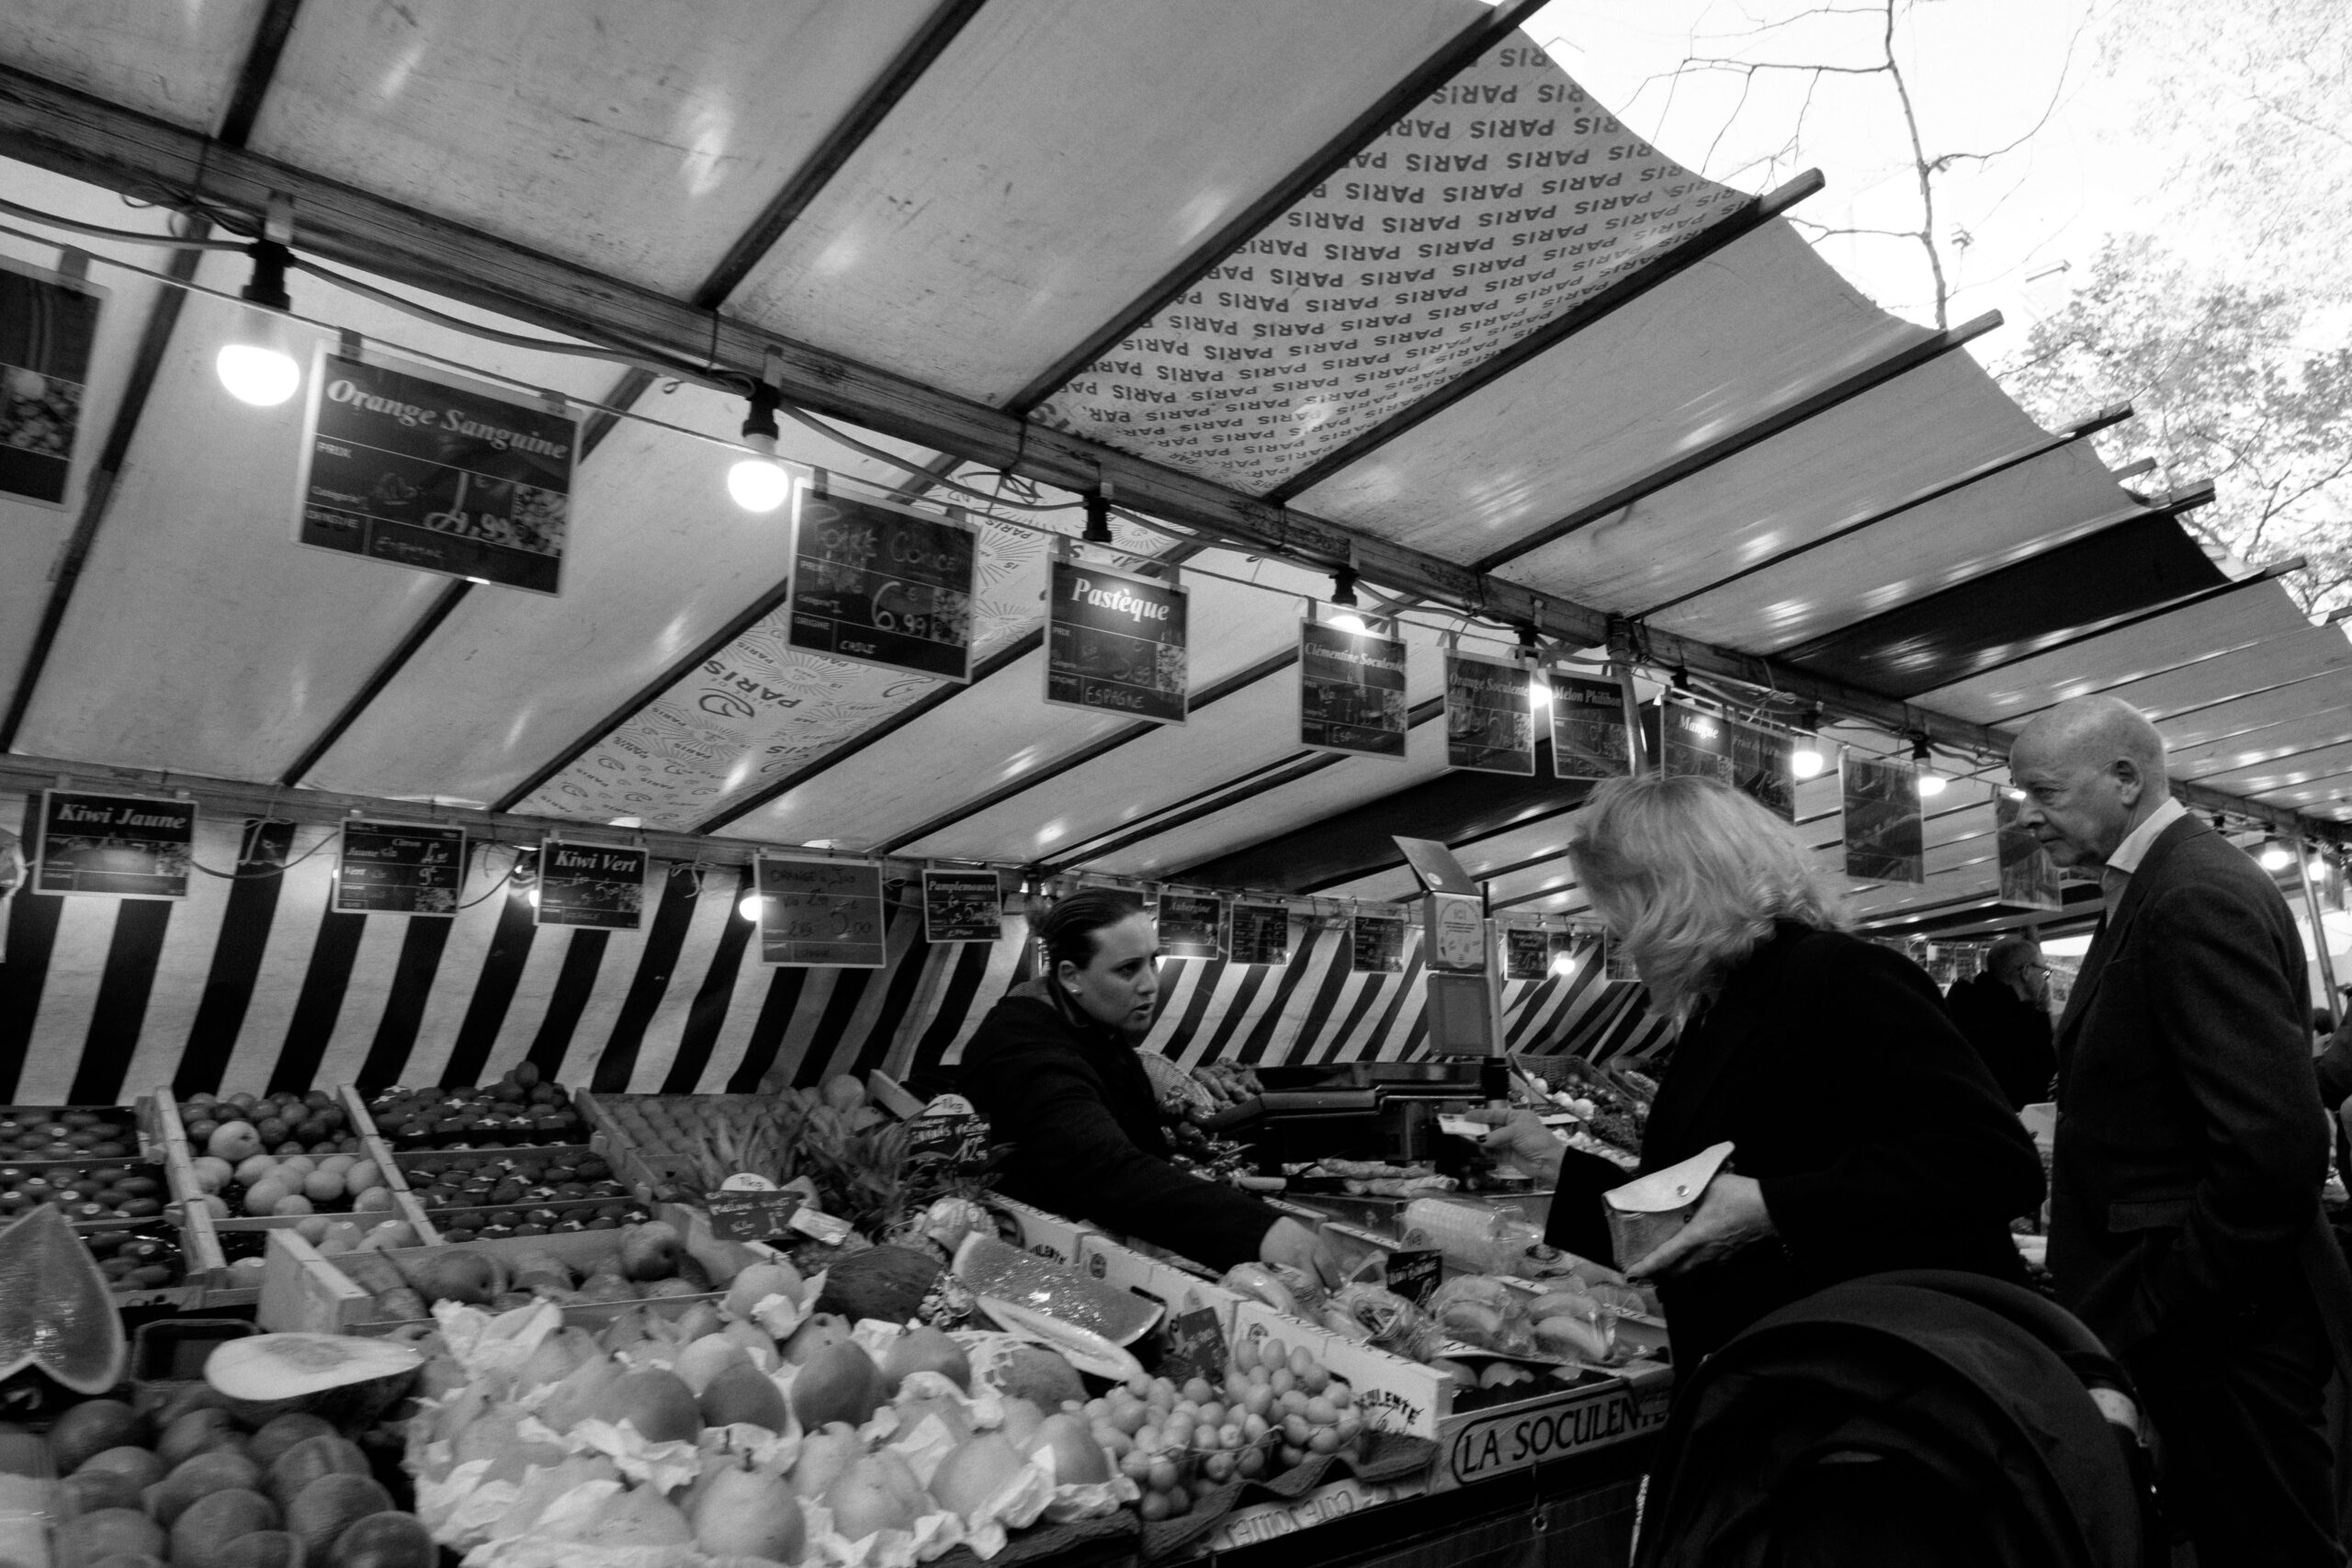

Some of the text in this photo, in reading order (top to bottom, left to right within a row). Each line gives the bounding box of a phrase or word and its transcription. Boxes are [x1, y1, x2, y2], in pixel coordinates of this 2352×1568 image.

[1499, 48, 1548, 67] RIS
[1432, 85, 1584, 105] RIS PARIS
[1385, 117, 1619, 140] RIS PARIS PAR
[1507, 150, 1589, 169] PARIS
[1609, 142, 1653, 161] RIS
[1406, 153, 1488, 172] PARIS
[1346, 165, 1683, 204] RIS PARIS PARIS PARIS
[1288, 180, 1711, 233] RIS PARIS PARIS PARIS PARIS
[1696, 188, 1736, 208] RIS
[1605, 204, 1680, 230] PARIS
[1512, 223, 1589, 246] PARIS
[1325, 244, 1400, 261] PARIS
[1419, 237, 1495, 258] PARIS
[1544, 237, 1618, 261] PARIS
[1203, 266, 1253, 281] PAR
[1453, 255, 1526, 276] PARIS
[1270, 268, 1343, 288] PARIS
[1361, 268, 1435, 287] PARIS
[1485, 268, 1556, 292] PARIS
[1395, 286, 1468, 304] PARIS
[1515, 276, 1583, 304] PARIS
[1219, 292, 1289, 313] PARIS
[1306, 297, 1379, 312] PARIS
[1428, 299, 1499, 320] PARIS
[1169, 316, 1238, 335] PARIS
[1253, 323, 1324, 337] PARIS
[1341, 313, 1412, 332] PARIS
[1459, 308, 1527, 333] PARIS
[1374, 327, 1443, 346] PARIS
[1122, 340, 1189, 355] PARIS
[1205, 345, 1273, 360] PARIS
[1289, 339, 1358, 356] PARIS
[1240, 364, 1306, 379] PARIS
[1322, 354, 1390, 370] PARIS
[1158, 366, 1224, 382] PARIS
[1355, 364, 1420, 383] PARIS
[1412, 371, 1464, 392] ARIS
[1058, 382, 1097, 395] PAR
[1113, 384, 1176, 403] PARIS
[1192, 387, 1257, 401] PARIS
[1272, 377, 1340, 392] PARIS
[1226, 399, 1290, 412] PARIS
[1337, 391, 1397, 414] PARIS
[328, 380, 569, 459] Orange Sanguine
[1146, 408, 1210, 422] PARIS
[1180, 420, 1243, 432] PARIS
[1213, 430, 1274, 443] PARIS
[1244, 440, 1305, 454] PARIS
[985, 519, 1033, 540] PARIS
[1070, 577, 1170, 623] Pastèque
[794, 616, 831, 630] ORIGINE
[738, 642, 775, 664] PARIS
[703, 660, 803, 708] PARIS
[1449, 672, 1484, 690] Orange
[1554, 685, 1583, 703] Melon
[1679, 713, 1720, 740] Mangue
[57, 803, 187, 829] Kiwi Jaune
[555, 851, 637, 873] Kiwi Vert
[928, 881, 996, 894] Pamplemousse
[1462, 1429, 1501, 1475] LA
